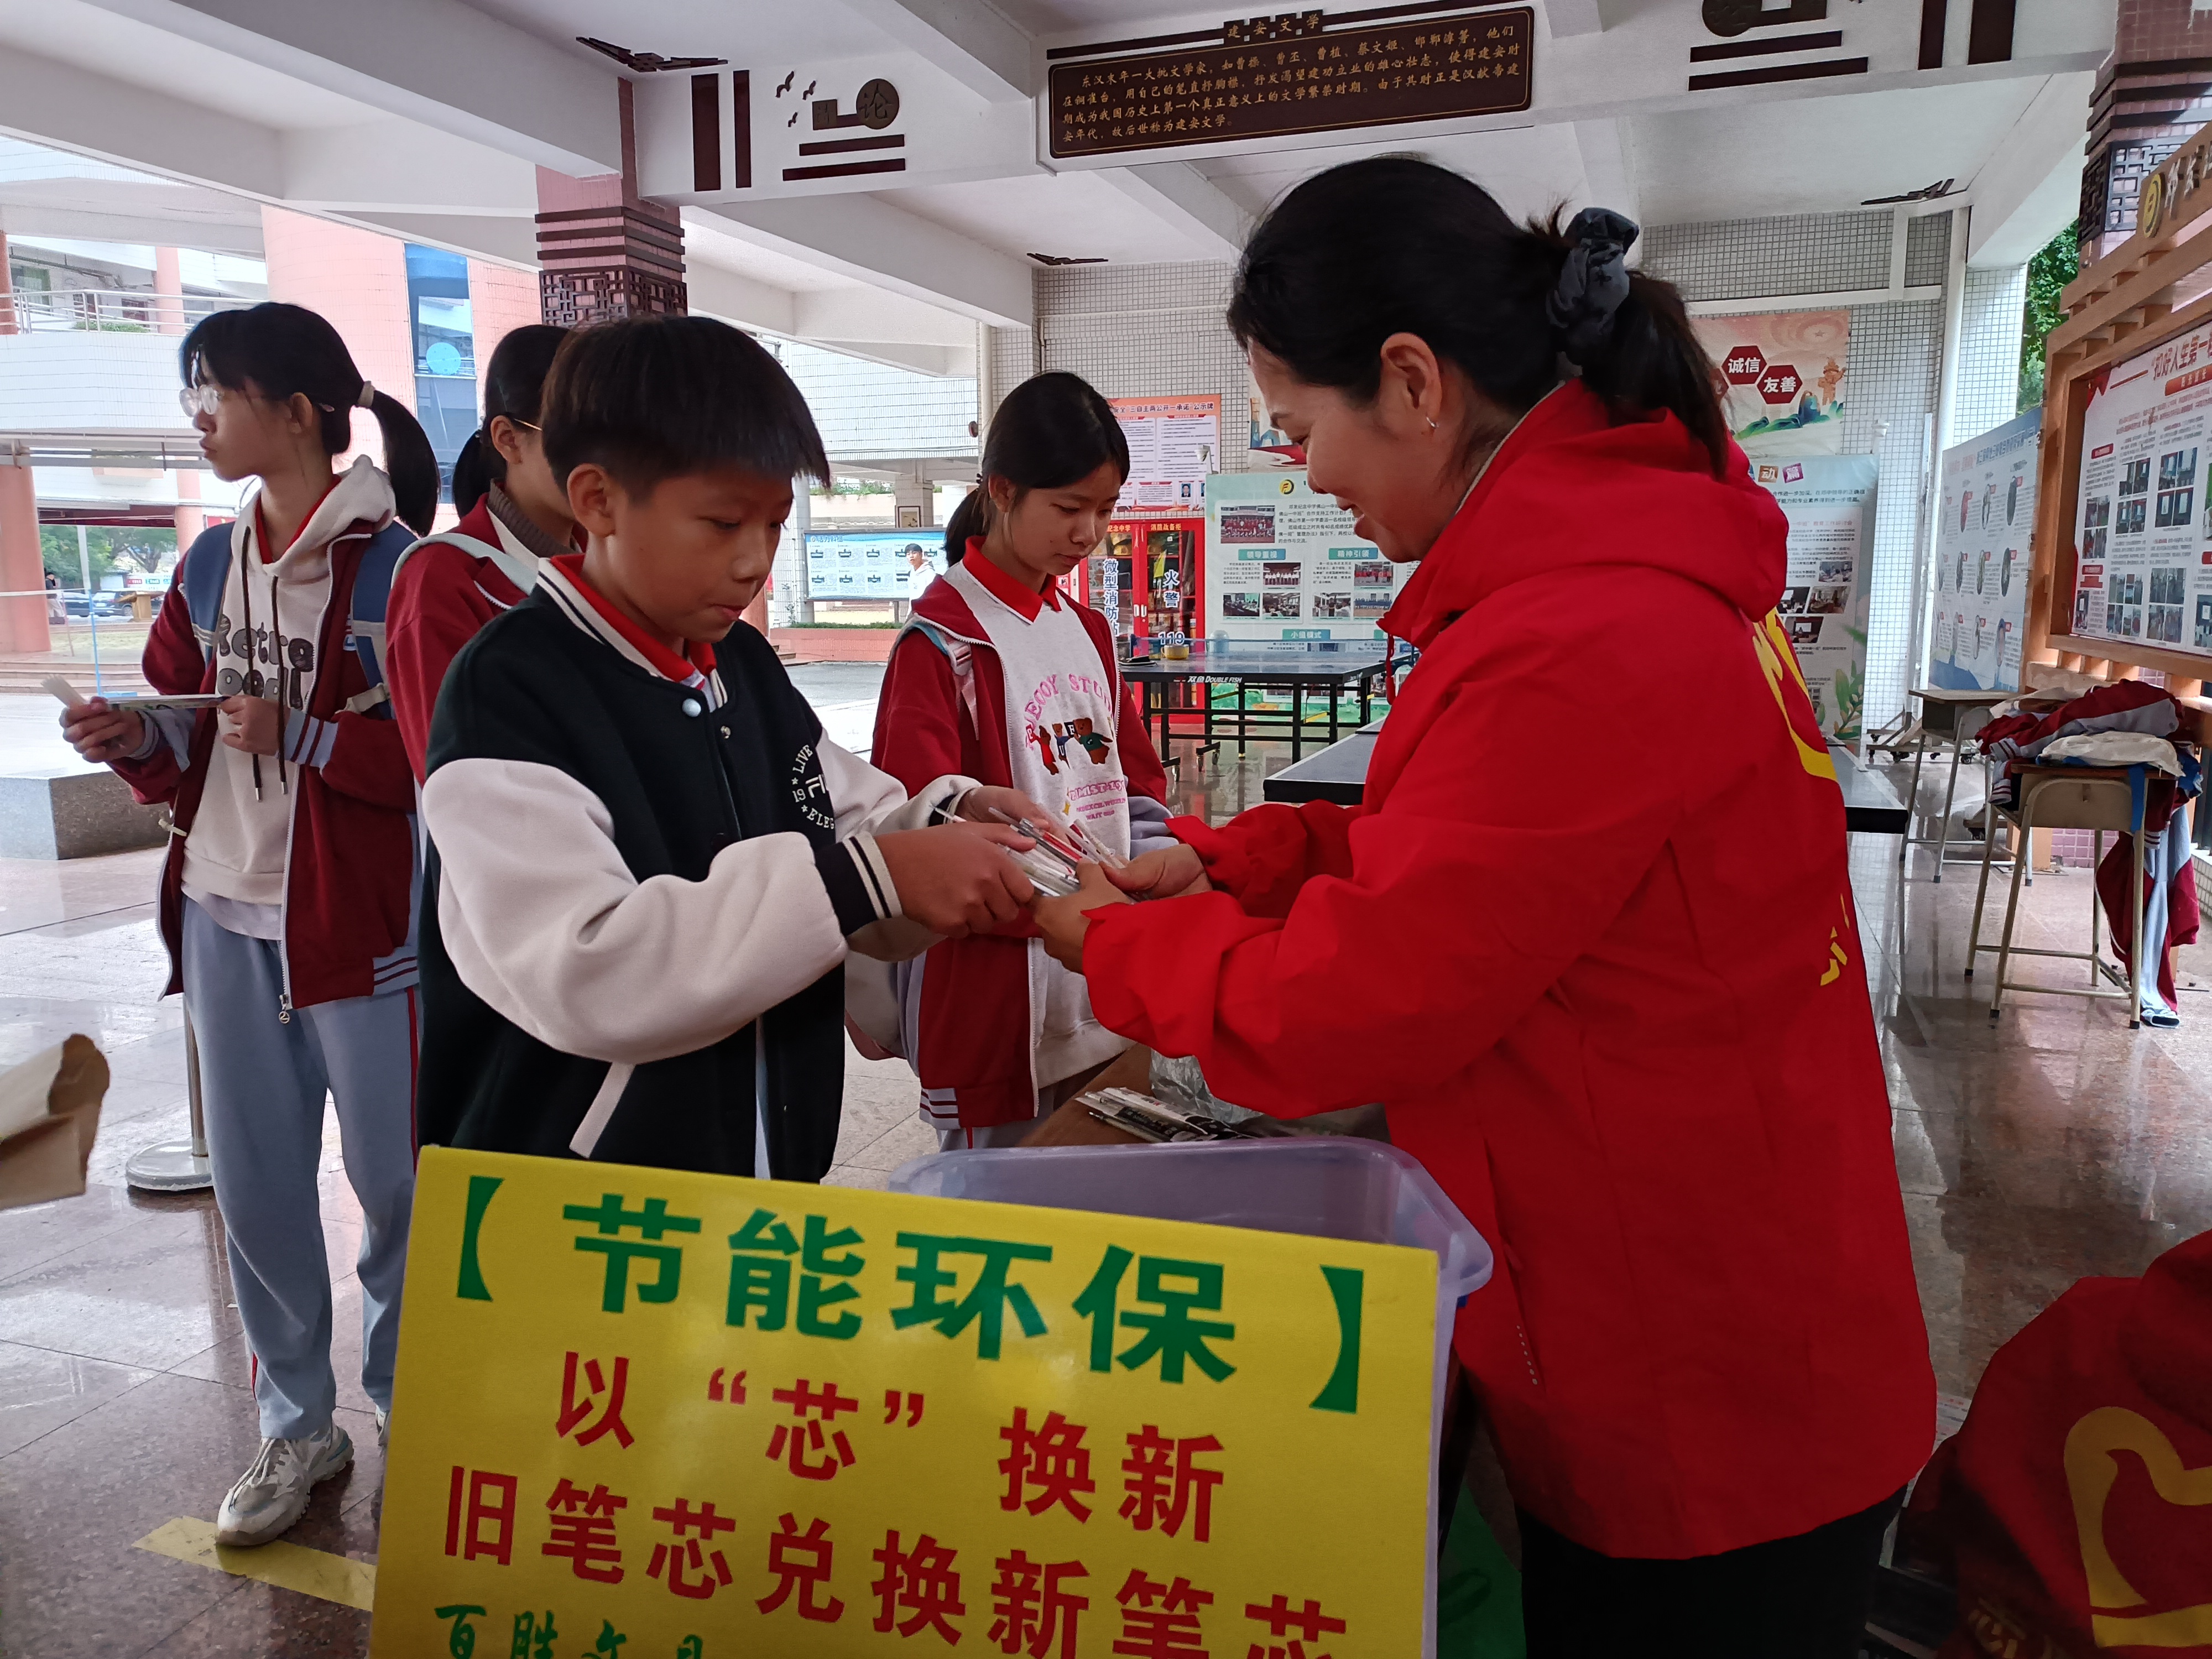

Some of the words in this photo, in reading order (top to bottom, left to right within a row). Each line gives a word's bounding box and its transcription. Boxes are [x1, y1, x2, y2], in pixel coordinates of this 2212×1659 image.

[1227, 13, 1319, 38] 建安文学
[1728, 357, 1761, 374] 诚信
[1763, 376, 1797, 393] 友善
[1337, 550, 1370, 558] 精神引领
[1162, 569, 1180, 608] 火警
[1158, 631, 1185, 645] 119
[792, 744, 813, 774] LIVE
[792, 789, 806, 802] 19
